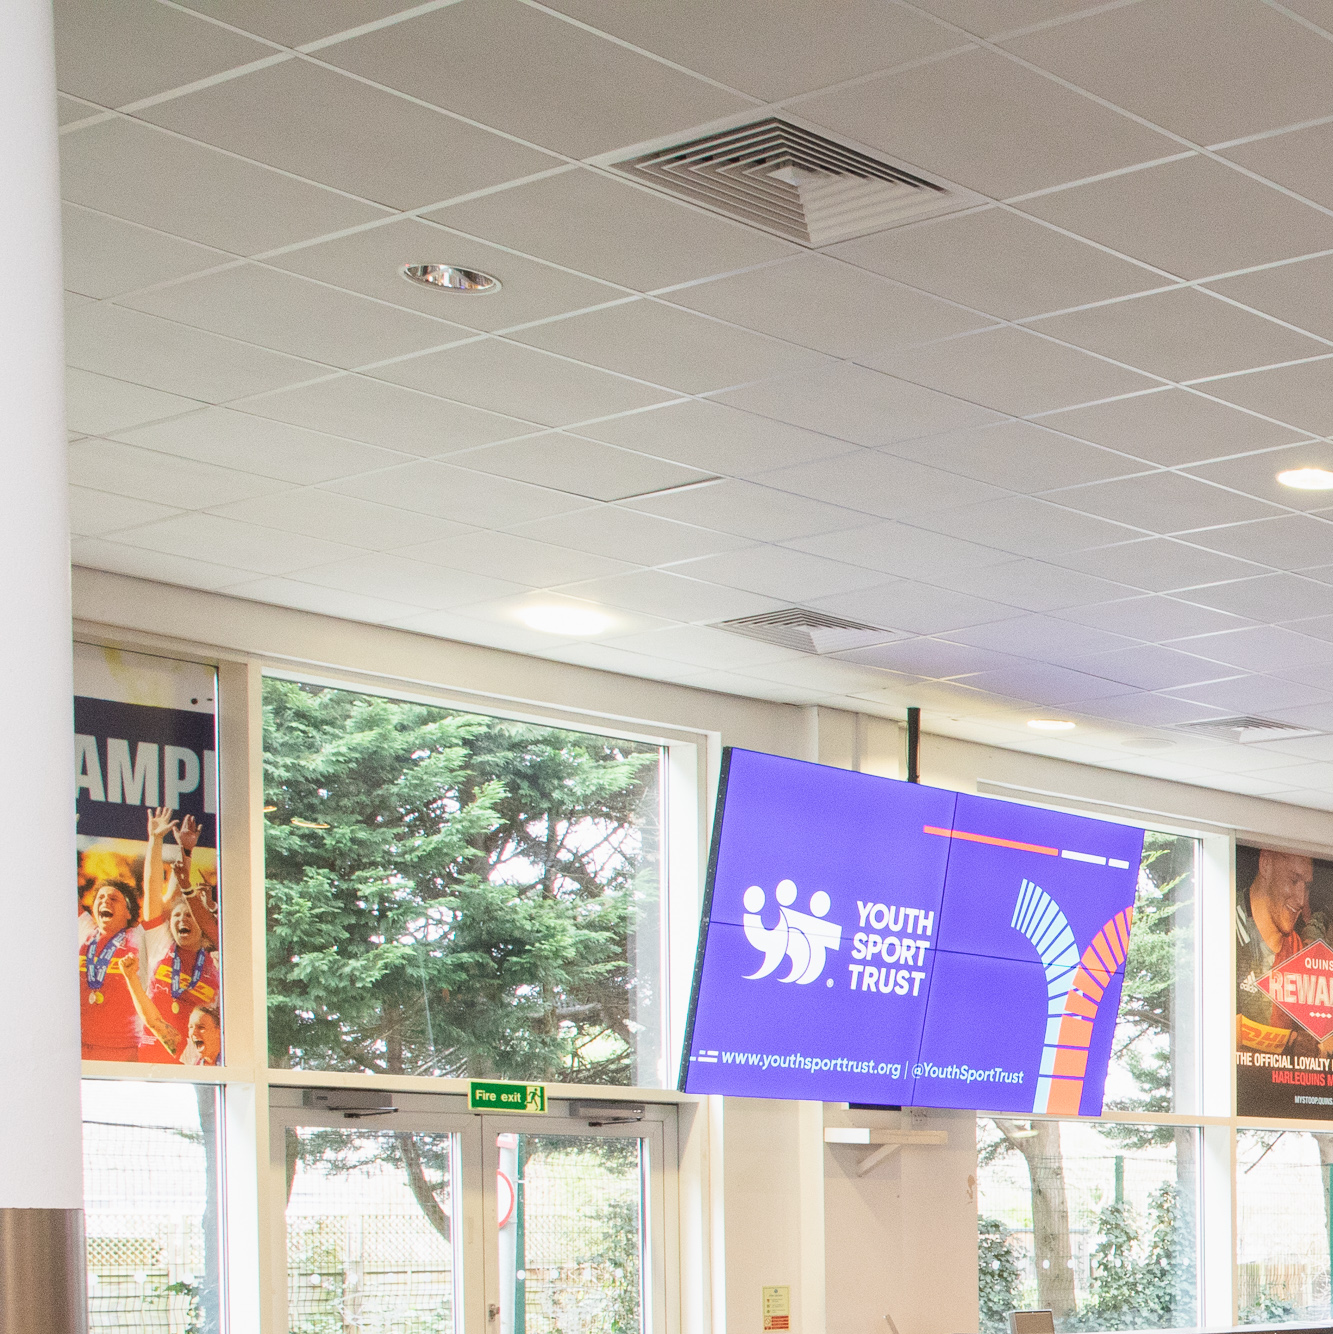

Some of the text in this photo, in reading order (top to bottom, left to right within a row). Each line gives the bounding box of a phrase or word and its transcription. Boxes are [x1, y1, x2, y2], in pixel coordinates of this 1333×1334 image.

[856, 900, 935, 936] YOUTH
[851, 932, 930, 967] SPORT
[848, 964, 926, 997] TRUST
[721, 1051, 901, 1079] www.youthsporttrust.org
[911, 1062, 1025, 1084] @YouthSportTrust
[1236, 1051, 1253, 1066] THE
[1254, 1053, 1293, 1070] OFFICIAL
[1294, 1056, 1330, 1072] LOYALTY
[1271, 1070, 1326, 1087] HARLEQUINS
[475, 1089, 522, 1103] Fire exit
